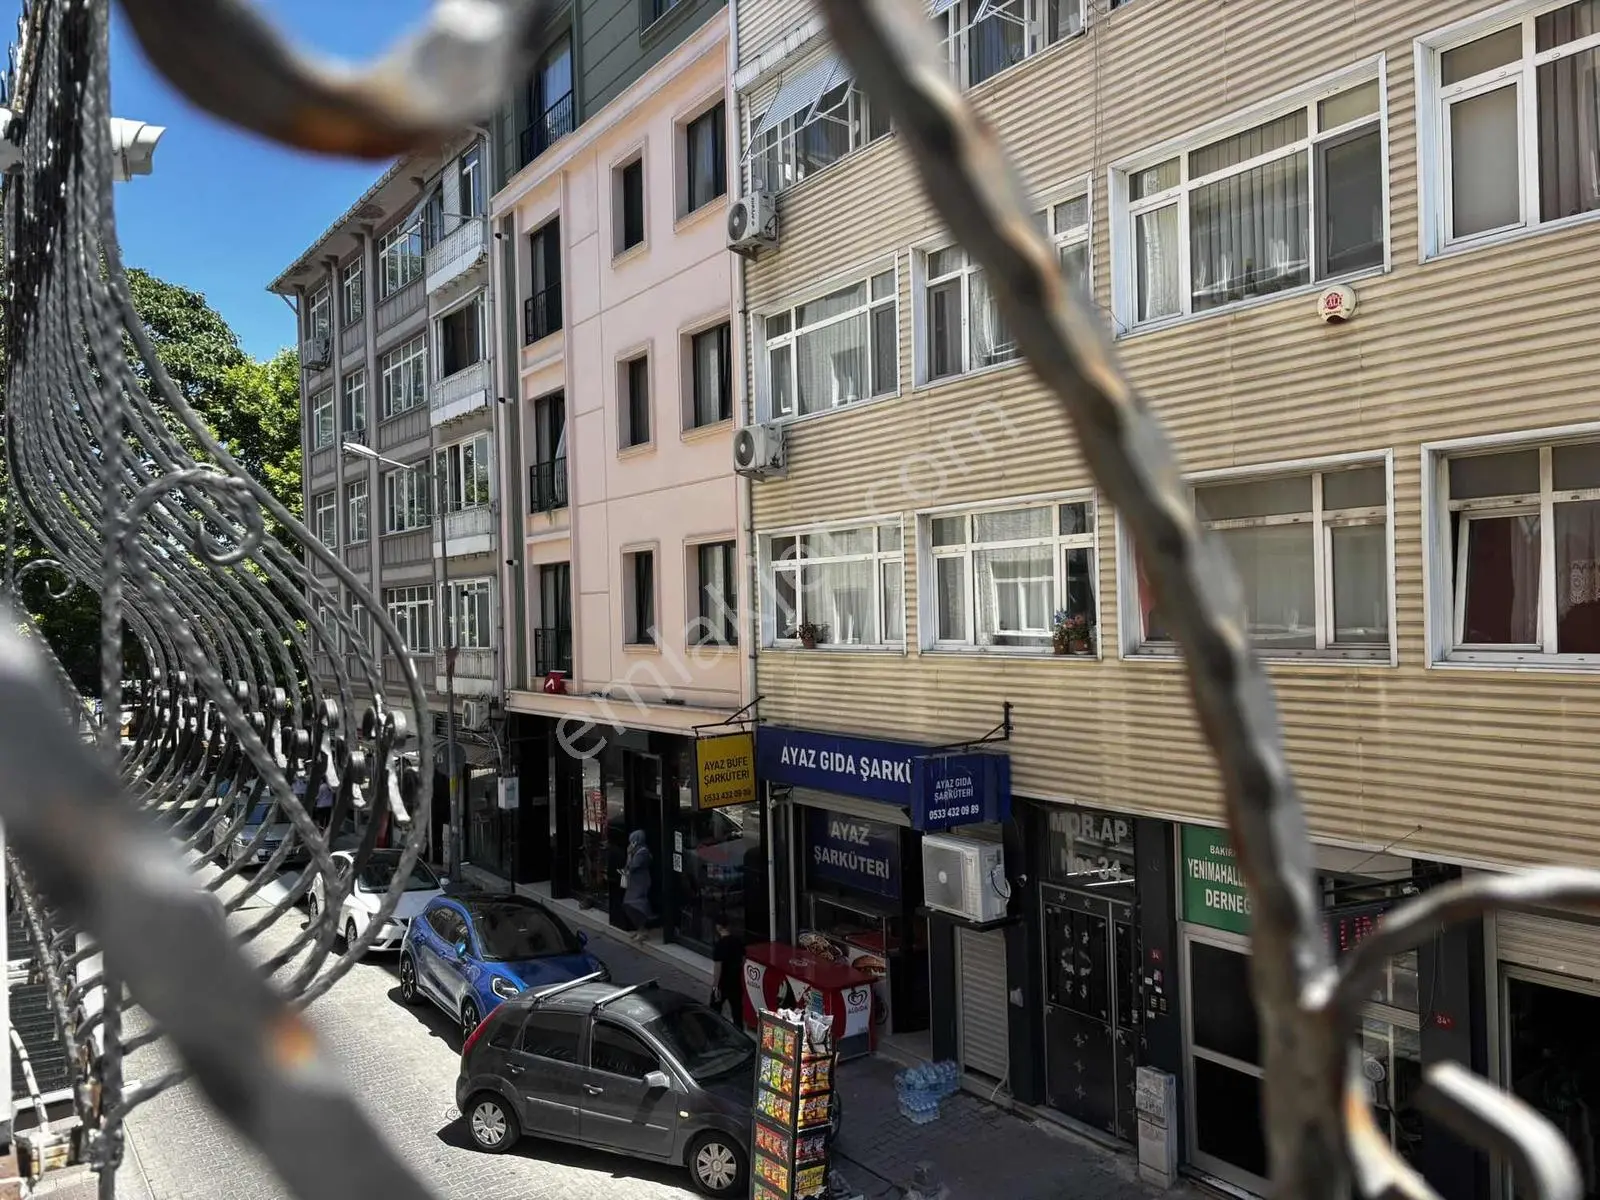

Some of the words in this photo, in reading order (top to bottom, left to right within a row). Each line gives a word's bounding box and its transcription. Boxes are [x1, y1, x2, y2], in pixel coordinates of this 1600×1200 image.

[704, 759, 726, 772] AYAZ
[781, 746, 816, 769] AYAZ
[820, 751, 857, 775] GIDA
[935, 779, 955, 790] AYAZ
[955, 776, 972, 788] GIDA
[934, 785, 974, 804] ŞARKÜTERİ
[929, 809, 947, 821] 0533
[947, 806, 961, 818] 432
[960, 805, 970, 816] 09
[970, 804, 980, 815] 89
[830, 820, 870, 846] AYAZ
[813, 844, 890, 880] ŞARKÜTERİ
[1097, 856, 1121, 882] 34
